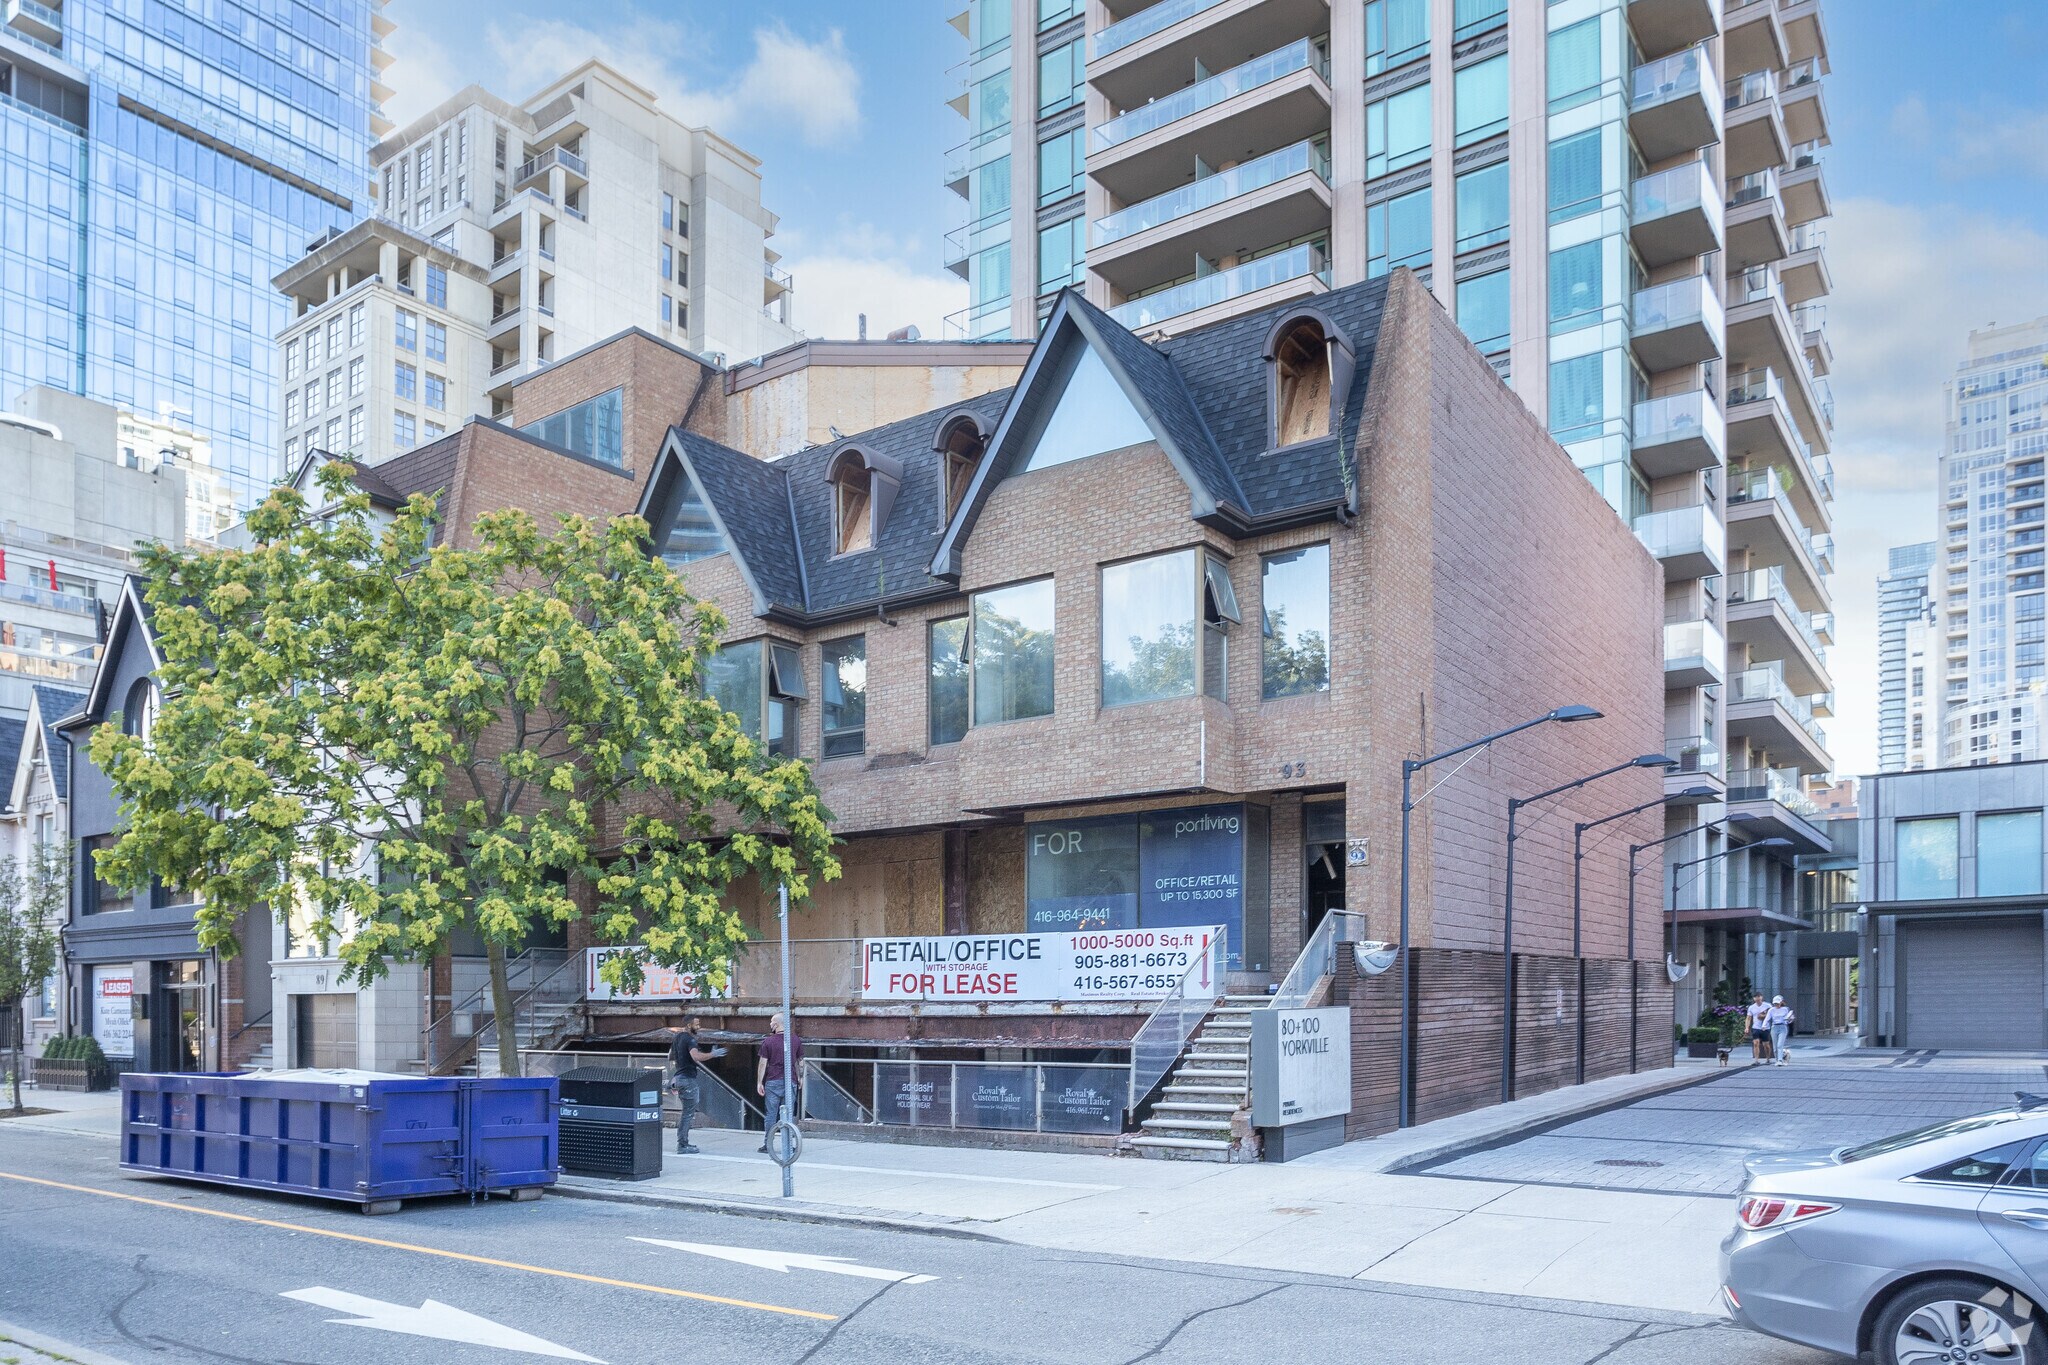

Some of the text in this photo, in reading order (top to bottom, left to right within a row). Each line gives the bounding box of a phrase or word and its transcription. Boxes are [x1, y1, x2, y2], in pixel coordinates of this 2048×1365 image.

[1281, 761, 1306, 779] 93
[1175, 813, 1239, 838] portliving
[1034, 831, 1082, 855] FOR
[1350, 852, 1365, 862] 93
[1155, 874, 1239, 890] OFFICE/RETAIL
[1160, 892, 1173, 901] UP
[1176, 890, 1190, 901] TO
[1225, 888, 1239, 899] SF
[1034, 907, 1110, 923] 416-964-9441
[1070, 933, 1194, 950] 1000-5000 Sq.ft
[869, 938, 1041, 962] RETAIL/OFFICE
[926, 963, 988, 972] WITH STORAGE
[1074, 952, 1188, 969] 905-881-6673
[316, 974, 325, 985] 89
[889, 973, 1018, 995] FOR LEASE
[1281, 1017, 1320, 1036] 80+100
[1282, 1037, 1329, 1057] YORKVILLE
[971, 1092, 1021, 1103] Custom Tailor
[978, 1086, 998, 1095] Royal
[1065, 1088, 1087, 1098] Royal
[1058, 1095, 1112, 1106] Custom Tailor
[560, 1107, 571, 1116] Litter
[637, 1111, 651, 1120] Litter
